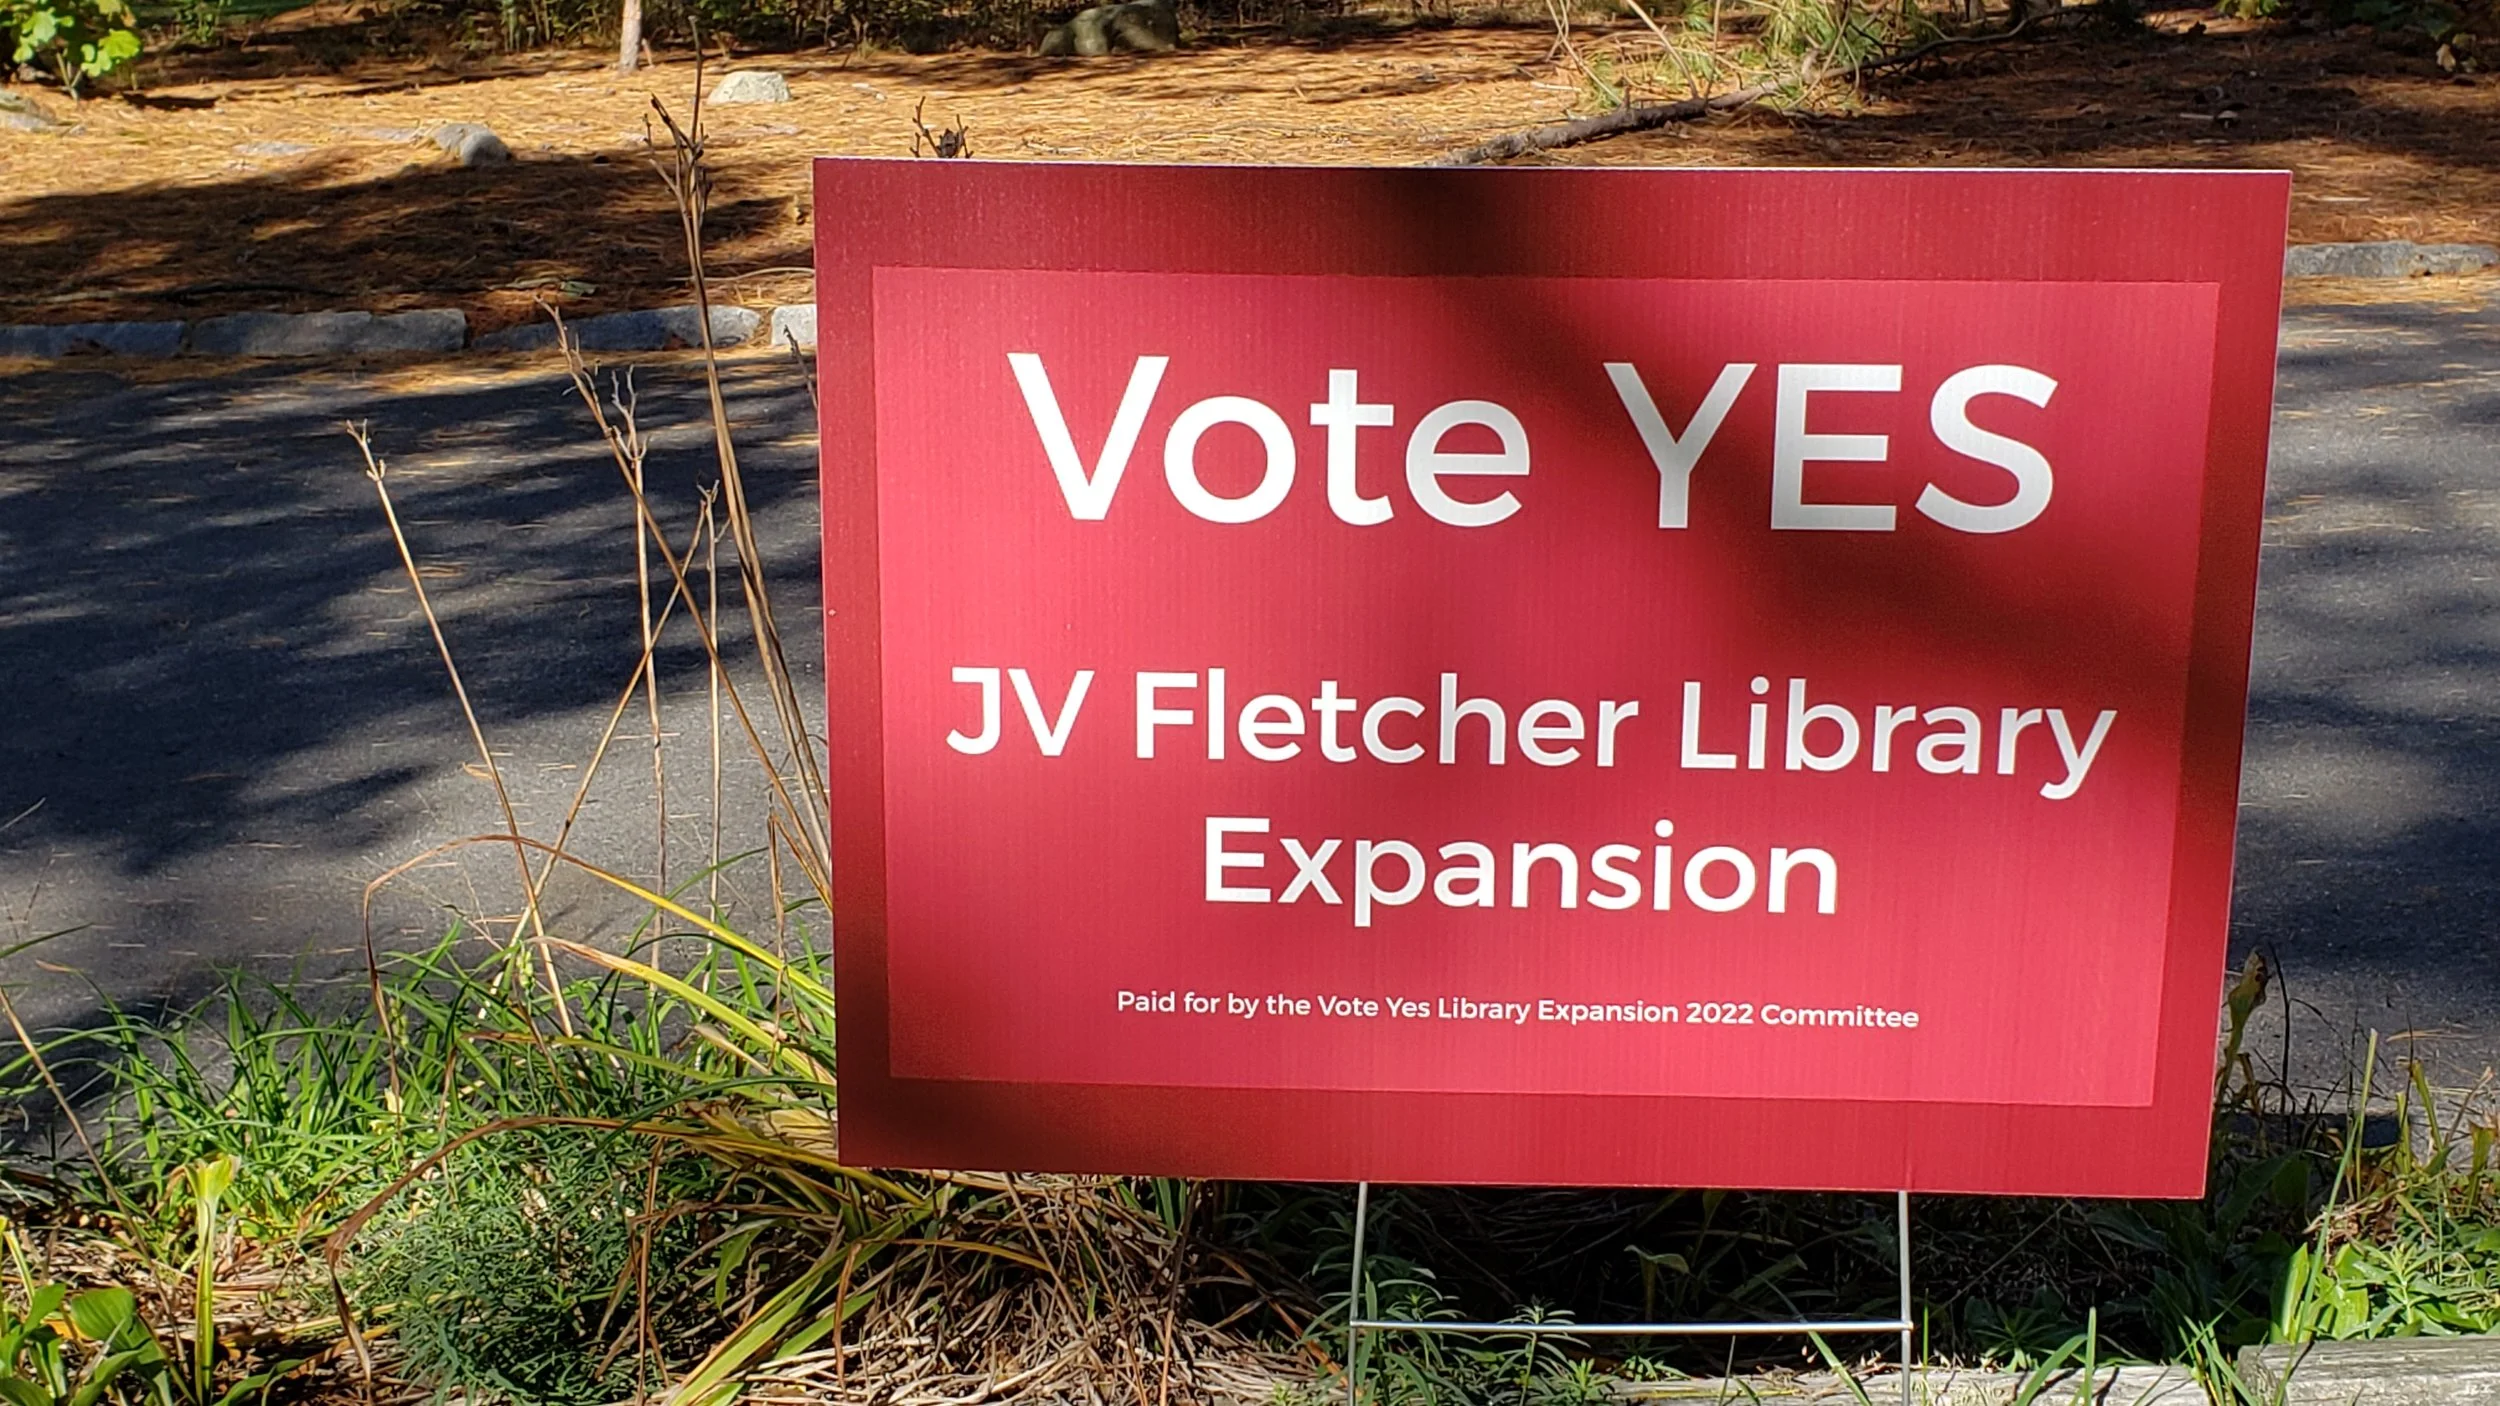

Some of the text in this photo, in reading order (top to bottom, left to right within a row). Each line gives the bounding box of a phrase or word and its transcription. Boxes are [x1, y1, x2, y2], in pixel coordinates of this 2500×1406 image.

[1006, 352, 2059, 534] Vote YES
[945, 666, 2117, 800] JV Fletcher Library
[1205, 816, 1838, 928] Expansion
[1118, 990, 1920, 1028] Paid for by the Vote Yes Library Expansion 2022 Committee
